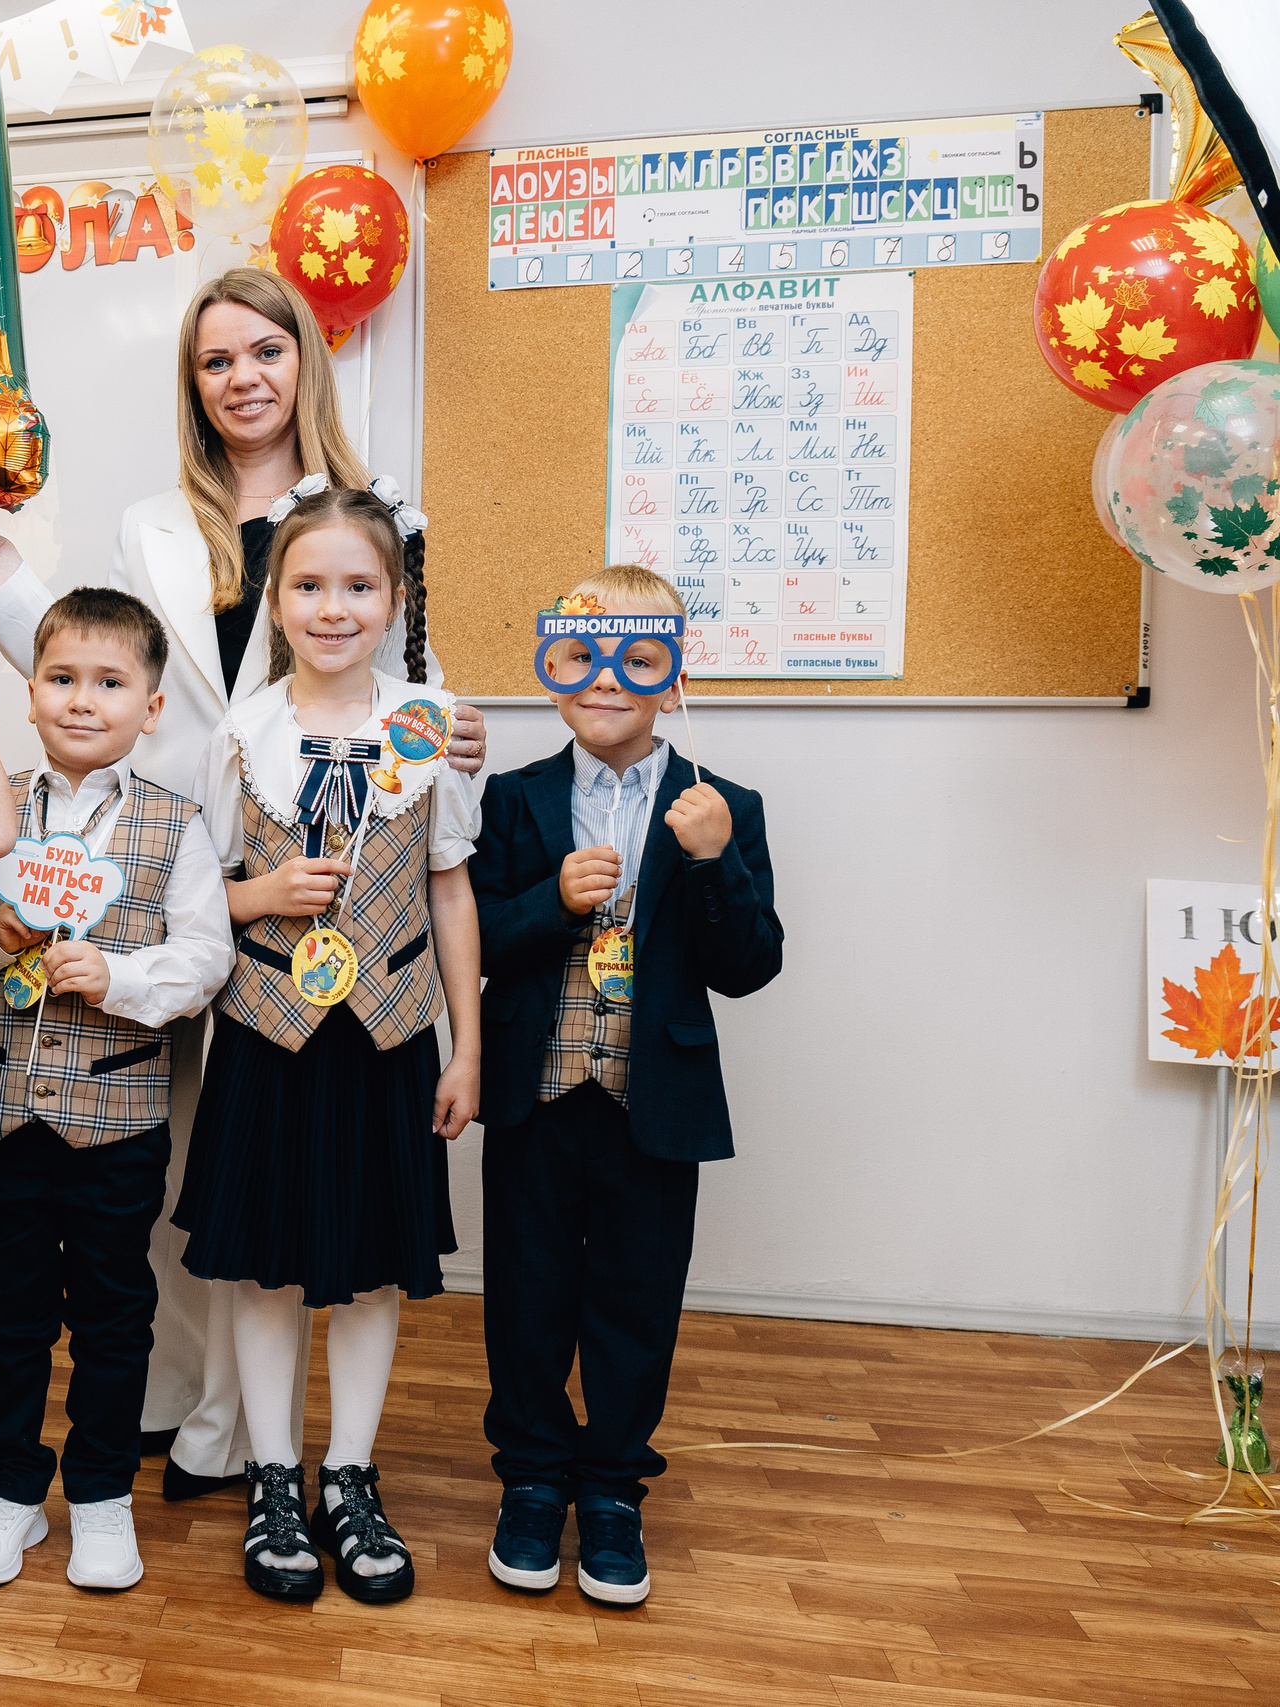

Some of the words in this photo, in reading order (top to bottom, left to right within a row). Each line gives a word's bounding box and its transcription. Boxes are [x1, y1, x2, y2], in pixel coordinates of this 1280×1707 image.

[764, 127, 860, 144] СОГЛАСНЫЕ
[517, 146, 589, 162] ГЛАСНЫЕ
[967, 150, 1001, 158] СОГЛАСНЫЕ
[677, 209, 710, 217] СОГЛАСНЫЕ
[818, 226, 856, 234] СОГЛАСНЫЕ
[525, 257, 544, 283] 0
[580, 254, 593, 281] 1
[622, 251, 643, 278] 2
[673, 248, 693, 275] 3
[728, 245, 744, 272] 4
[775, 243, 797, 269] 5
[830, 240, 849, 267] 6
[883, 237, 902, 264] 7
[937, 234, 956, 261] 8
[990, 231, 1010, 259] 9
[688, 277, 841, 303] АЛФАВИТ
[685, 303, 748, 318] Прописные
[758, 302, 803, 312] печатные
[805, 300, 835, 310] буквы
[628, 323, 648, 334] Аа
[682, 319, 702, 332] Бб
[736, 317, 757, 329] Вв
[792, 315, 807, 327] Гг
[848, 313, 870, 326] Дд
[627, 374, 646, 385] Ее
[681, 370, 699, 384] Ёё
[737, 369, 765, 381] Жж
[791, 367, 811, 380] Зз
[847, 366, 869, 377] Ии
[626, 423, 646, 438] Йй
[680, 423, 700, 435] Кк
[734, 422, 755, 434] Лл
[789, 420, 818, 432] Мм
[845, 418, 867, 430] Нн
[625, 475, 646, 486] Оо
[679, 473, 699, 485] Пп
[734, 472, 754, 486] Рр
[788, 470, 809, 483] Сс
[845, 469, 862, 481] Тт
[624, 526, 642, 540] Уу
[678, 525, 703, 538] Фф
[732, 524, 751, 536] Хх
[787, 523, 809, 536] Цц
[843, 522, 864, 534] Чч
[677, 576, 706, 589] Щщ
[544, 618, 677, 635] ПЕРВОКЛАШКА
[729, 626, 750, 638] Яя
[792, 631, 837, 641] гласные
[839, 630, 873, 643] буквы
[786, 657, 844, 667] согласные
[844, 656, 878, 669] буквы
[391, 712, 414, 726] ХОЧУ
[411, 718, 427, 733] ВСЕ
[423, 727, 443, 748] ЗНАТЬ
[45, 846, 84, 866] БУДУ
[17, 859, 104, 894] УЧИТЬСЯ
[21, 882, 50, 907] НА
[1177, 905, 1200, 941] 1
[618, 945, 629, 962] Я
[595, 962, 634, 972] ПЕРВОКЛАС
[615, 1502, 634, 1512] GEOX
